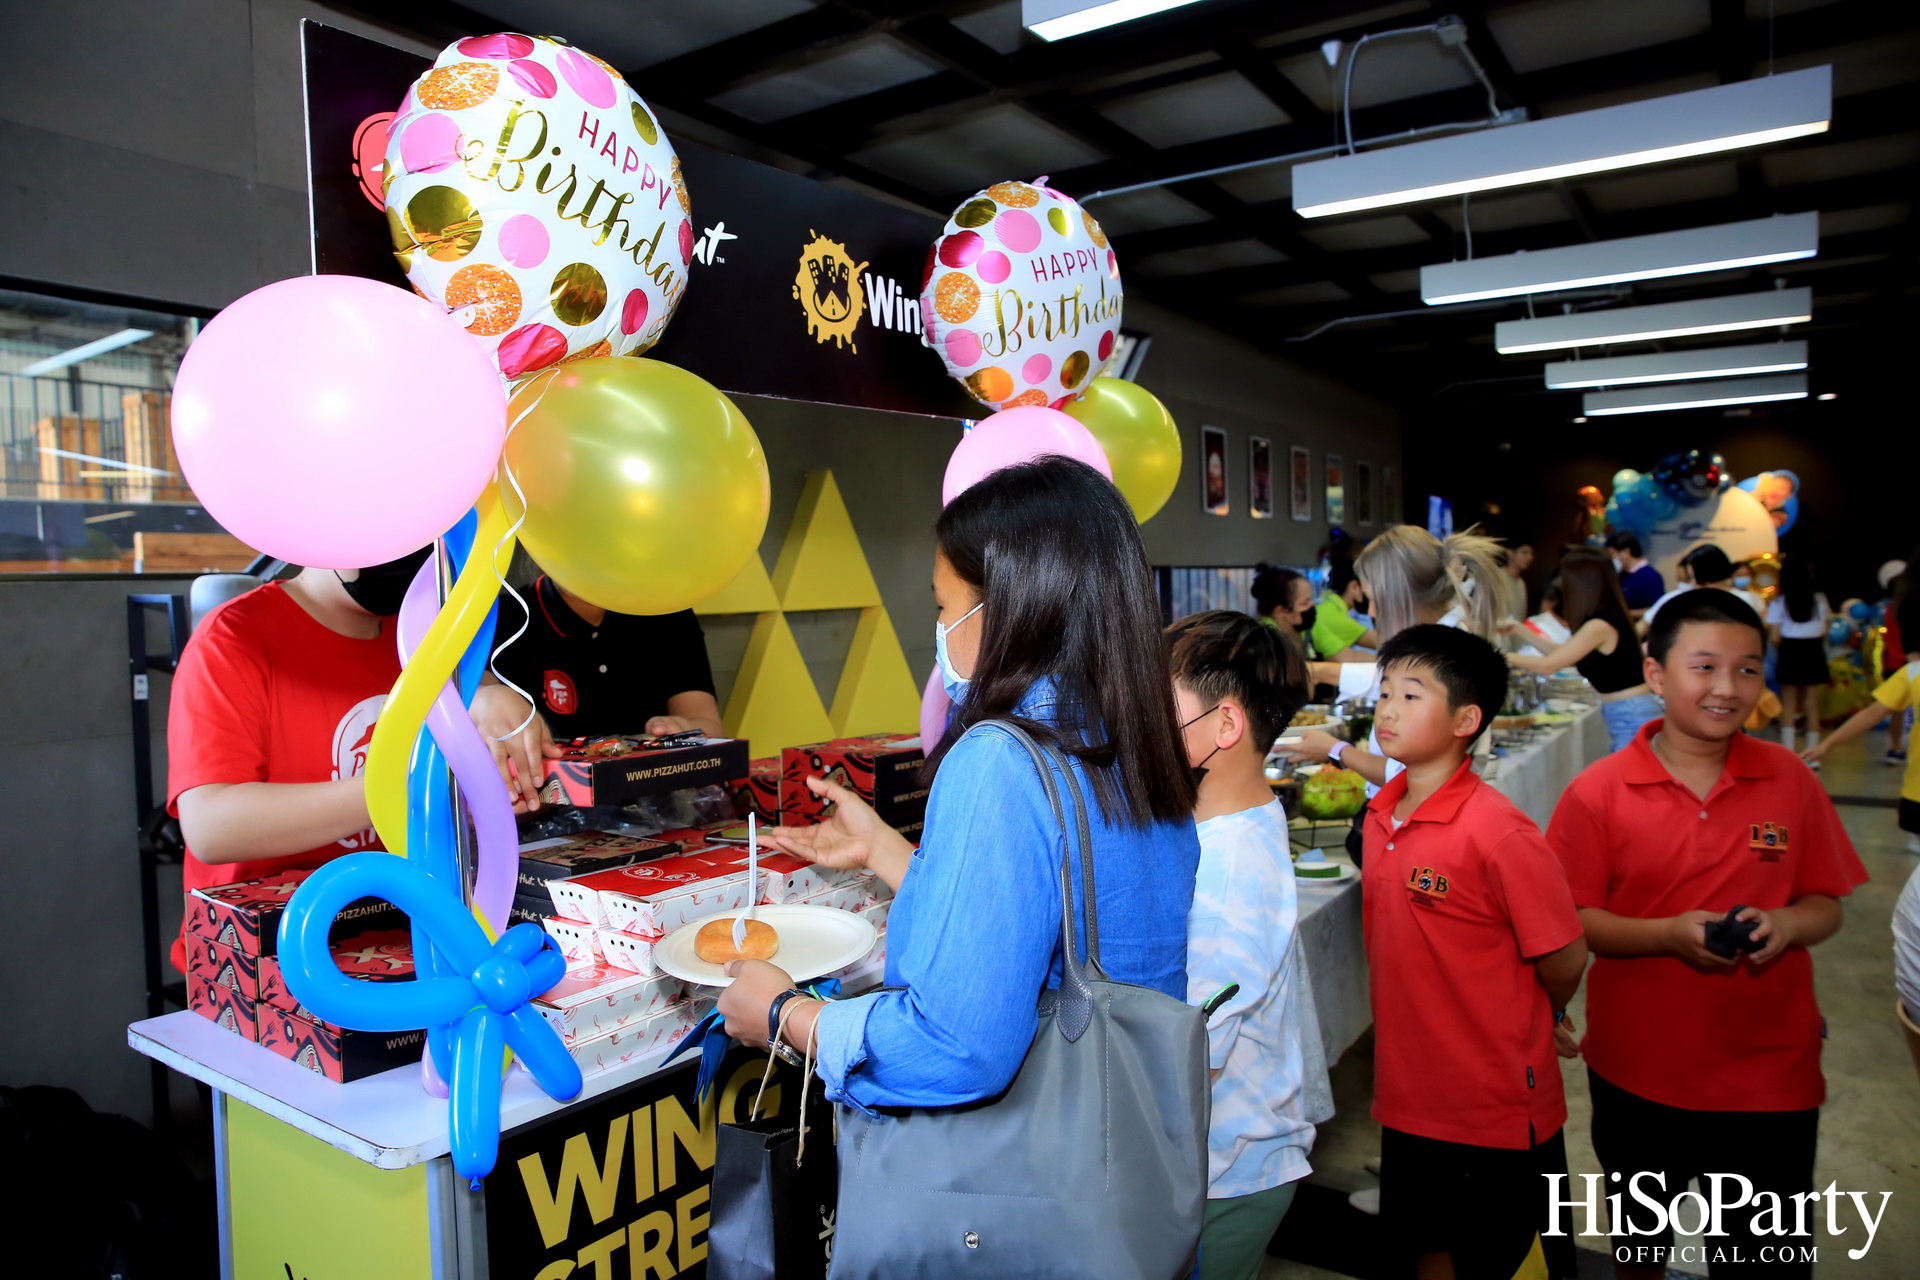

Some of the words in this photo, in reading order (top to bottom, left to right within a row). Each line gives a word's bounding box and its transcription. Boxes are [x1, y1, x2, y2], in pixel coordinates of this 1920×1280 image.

[578, 111, 672, 211] HAPPY
[1031, 248, 1098, 283] HAPPY
[865, 272, 925, 336] Win
[975, 274, 1123, 358] Birthda
[626, 757, 721, 782] WWW.PIZZAHUT.CO.TH
[516, 1057, 782, 1250] WING
